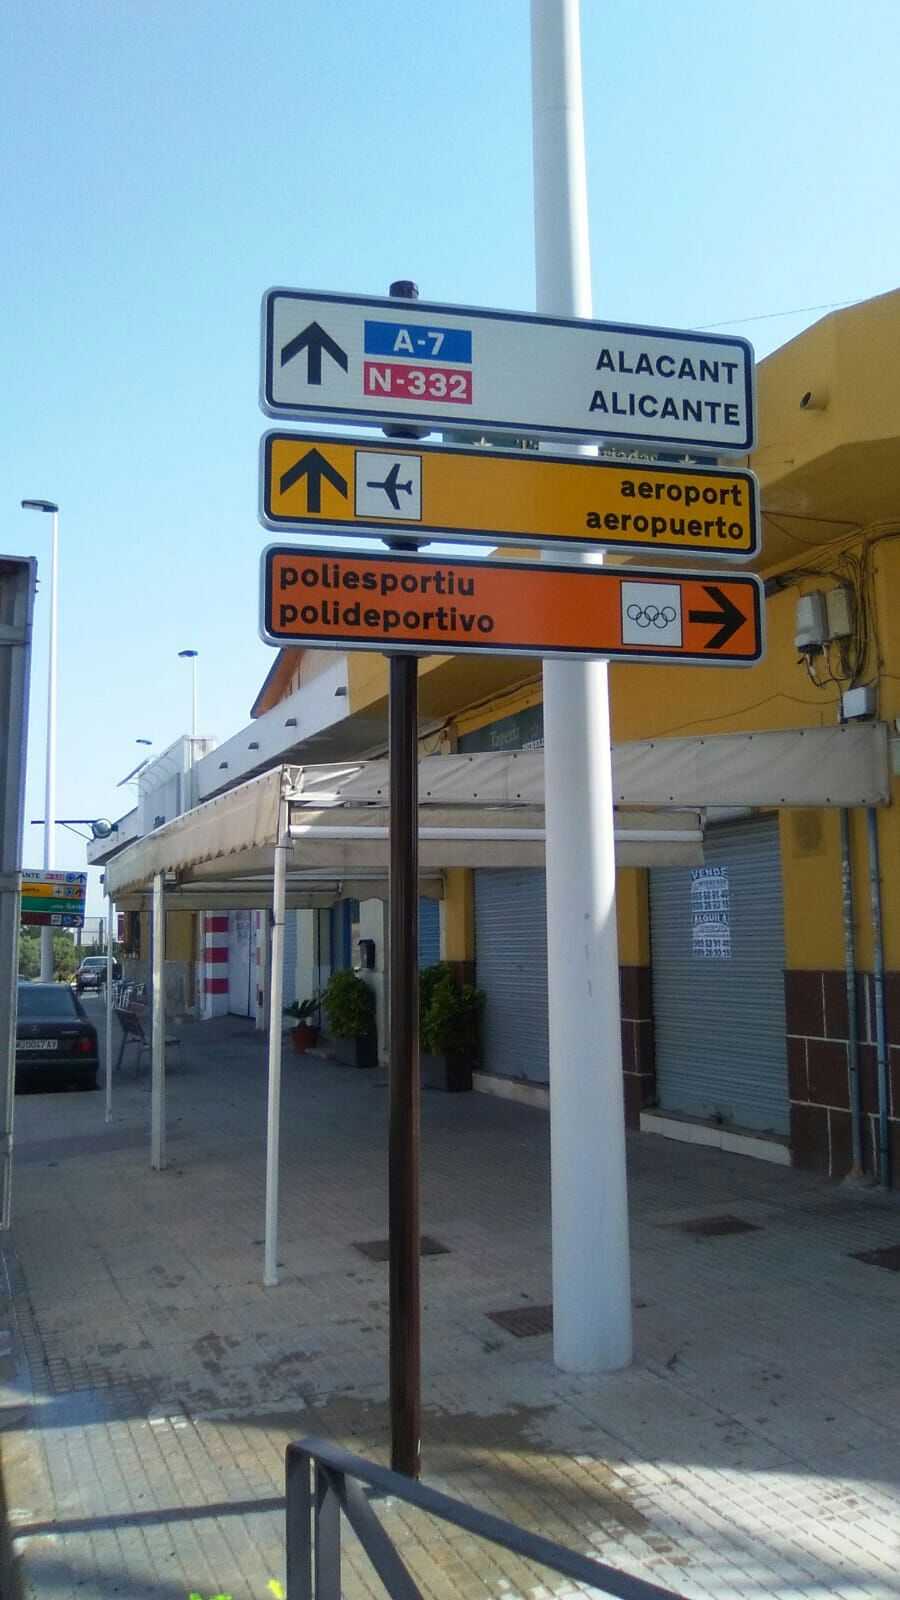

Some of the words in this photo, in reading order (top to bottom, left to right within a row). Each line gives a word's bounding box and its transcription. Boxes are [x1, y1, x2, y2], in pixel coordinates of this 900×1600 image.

[393, 329, 445, 355] A-7
[595, 348, 738, 385] ALACANT
[368, 367, 467, 399] N-332
[588, 390, 740, 426] ALICANTE
[620, 479, 743, 507] aeroport
[586, 511, 744, 540] aeropuerto
[280, 563, 475, 596] poliesportiu
[279, 600, 495, 632] polideportivo
